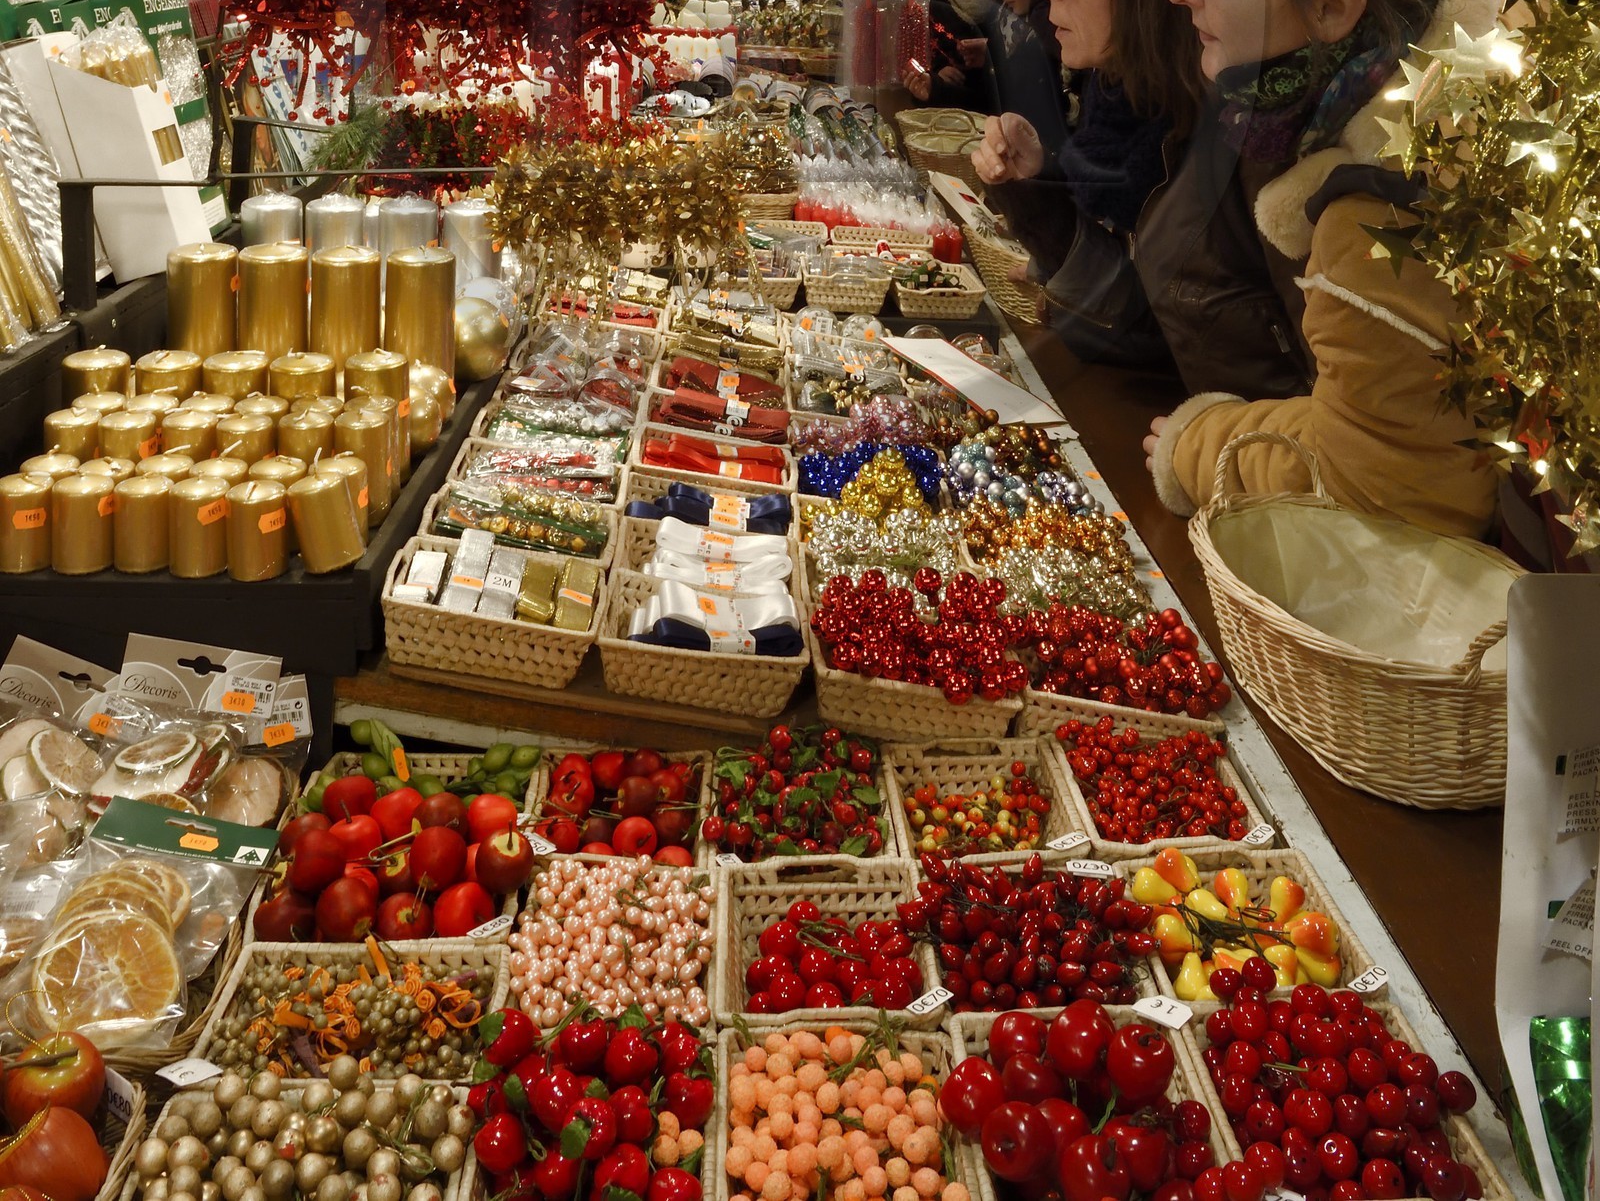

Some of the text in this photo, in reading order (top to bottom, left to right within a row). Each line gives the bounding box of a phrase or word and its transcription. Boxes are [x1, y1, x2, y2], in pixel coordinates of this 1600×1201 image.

[492, 576, 513, 589] 2M
[0, 676, 53, 708] Decoris
[121, 673, 178, 700] Decoris
[1568, 792, 1590, 802] PEEL
[1566, 808, 1597, 818] PRESS
[1565, 818, 1599, 826] FIRMLY
[1053, 833, 1085, 849] 0€70
[1246, 824, 1272, 843] 0€70
[1072, 861, 1110, 872] 0€70
[472, 917, 510, 937] 0€80
[1550, 938, 1571, 950] PEEL
[1354, 966, 1387, 992] 0€70
[910, 988, 949, 1013] 0€70
